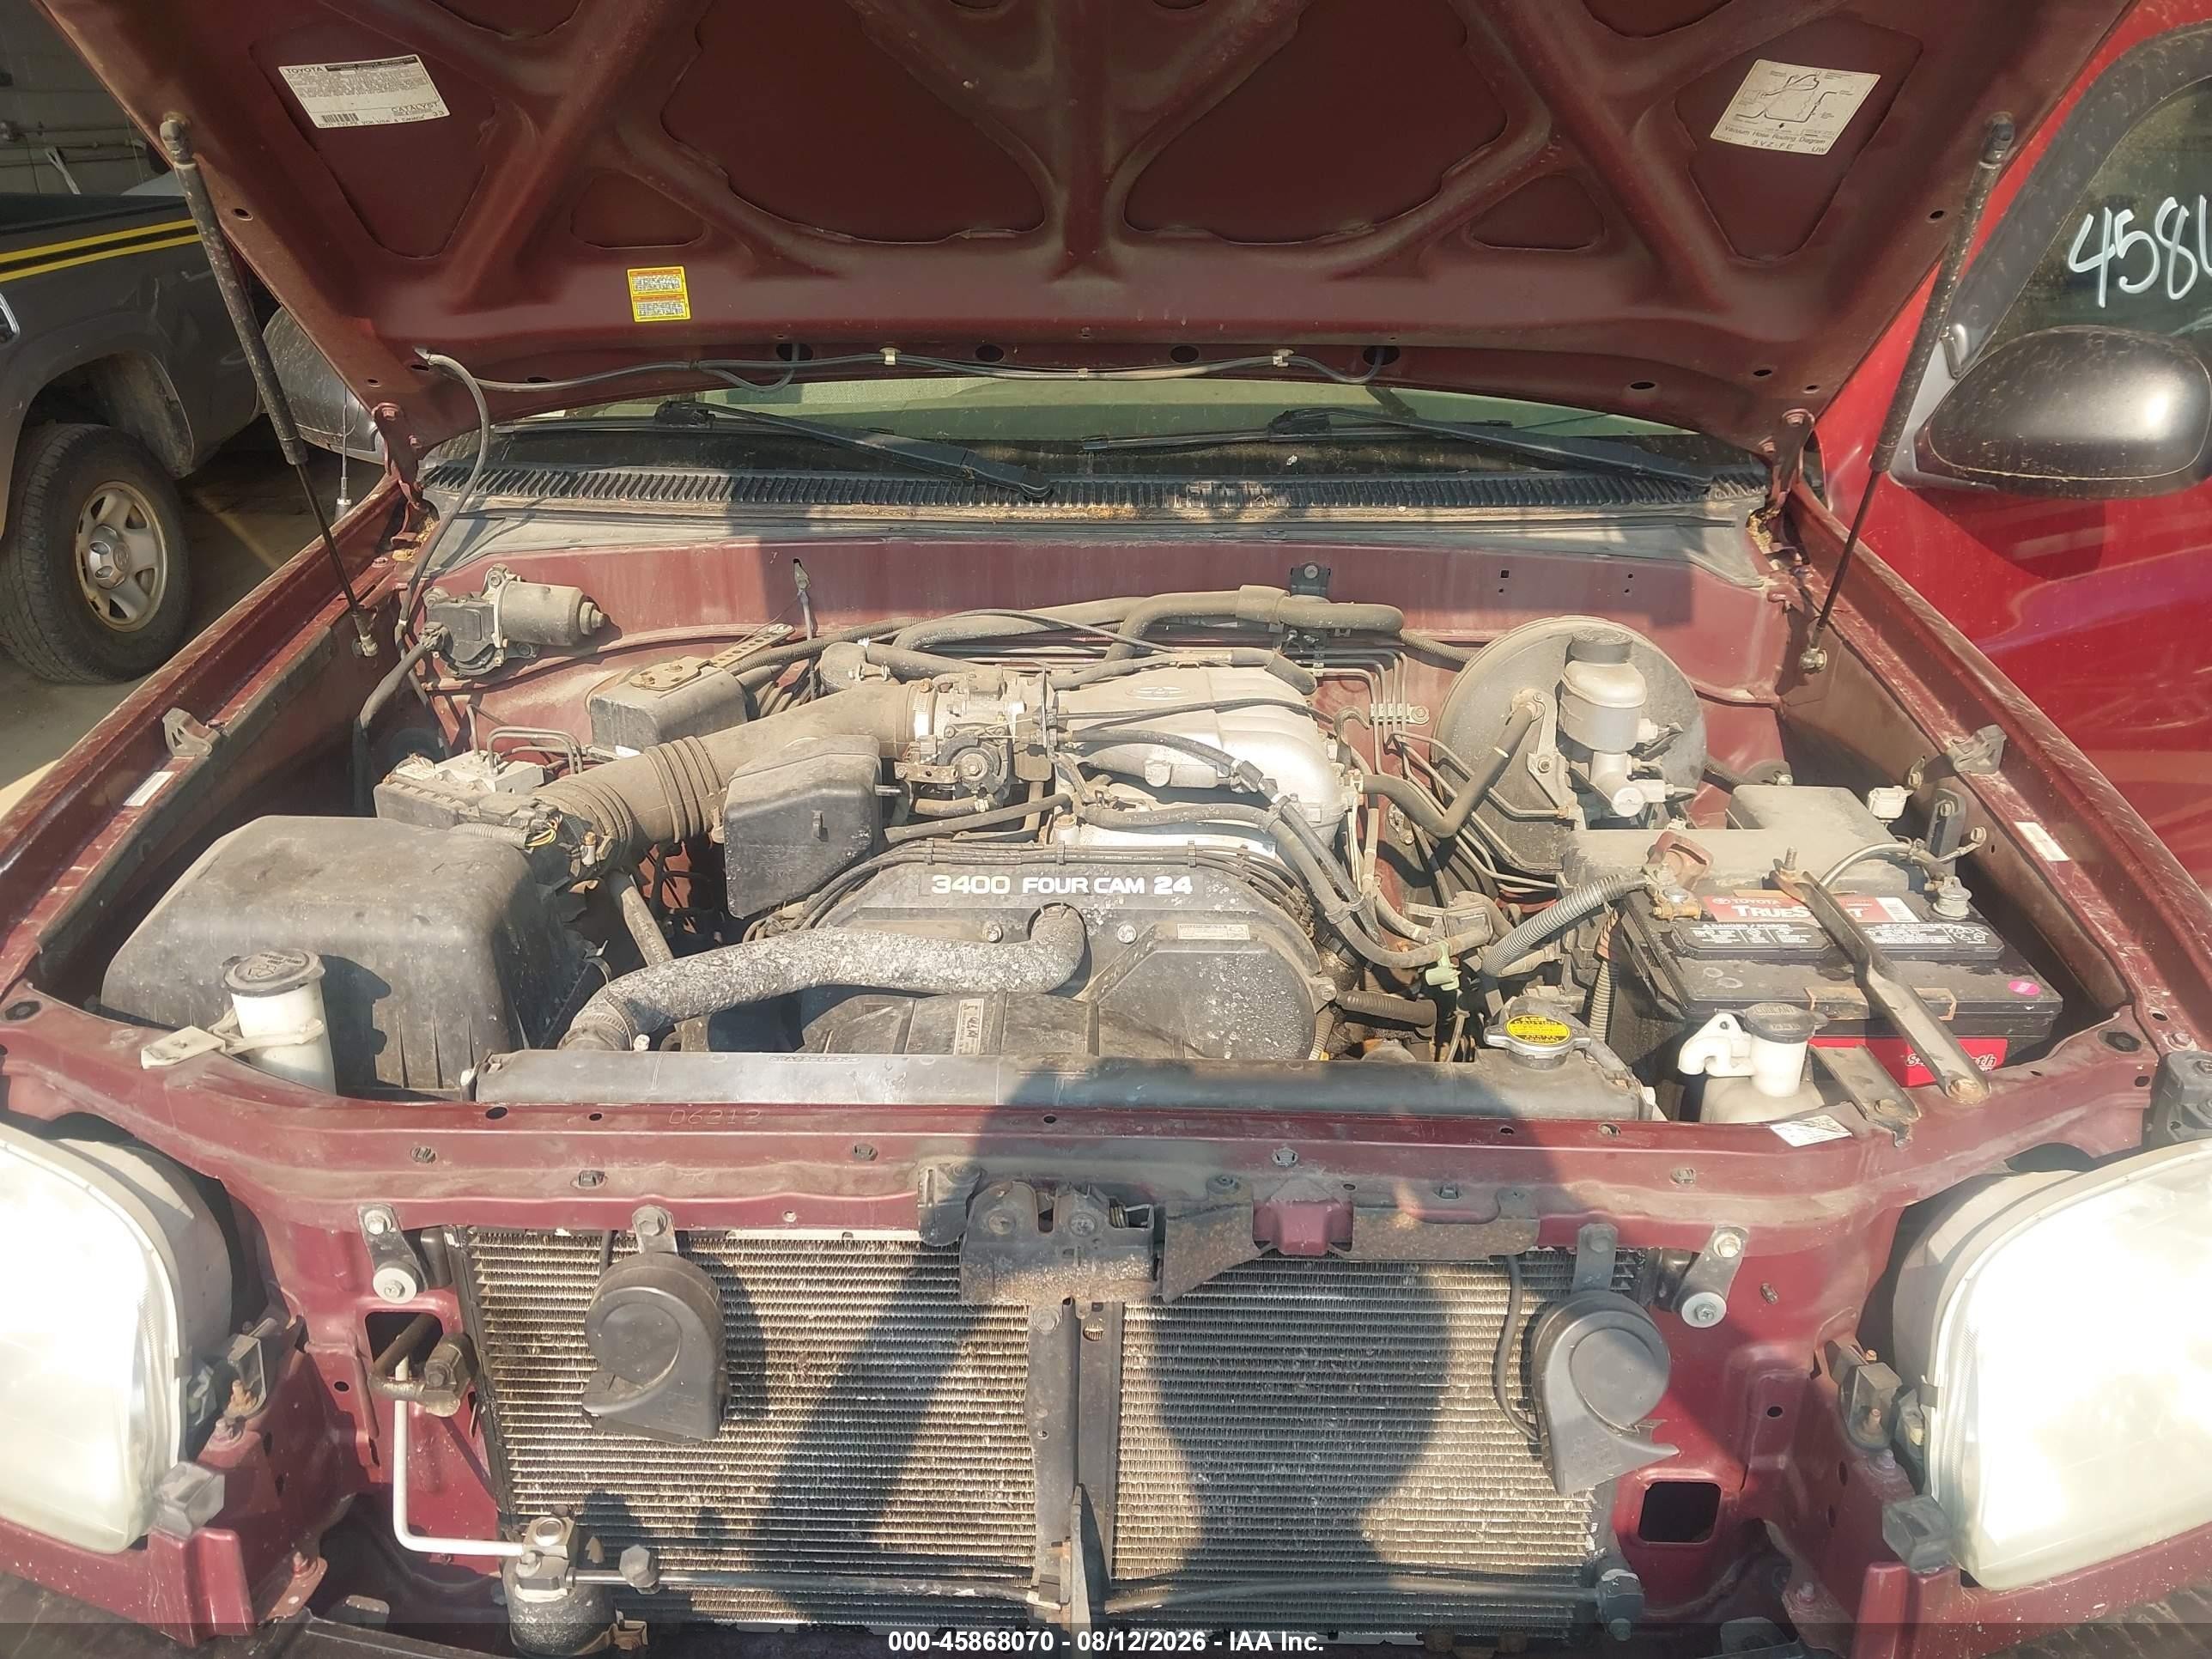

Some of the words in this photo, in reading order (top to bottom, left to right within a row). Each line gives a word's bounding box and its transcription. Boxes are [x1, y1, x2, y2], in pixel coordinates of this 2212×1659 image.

[286, 66, 324, 75] TOYOTA
[391, 101, 441, 113] CATALYST
[1724, 125, 1751, 136] Vacuum
[1753, 130, 1770, 138] Hose
[1772, 133, 1796, 143] Routing
[1799, 137, 1826, 145] Diagram
[932, 875, 1011, 895] 3400
[1022, 876, 1088, 895] FOUR
[1093, 876, 1146, 895] CAM
[1153, 875, 1194, 895] 24
